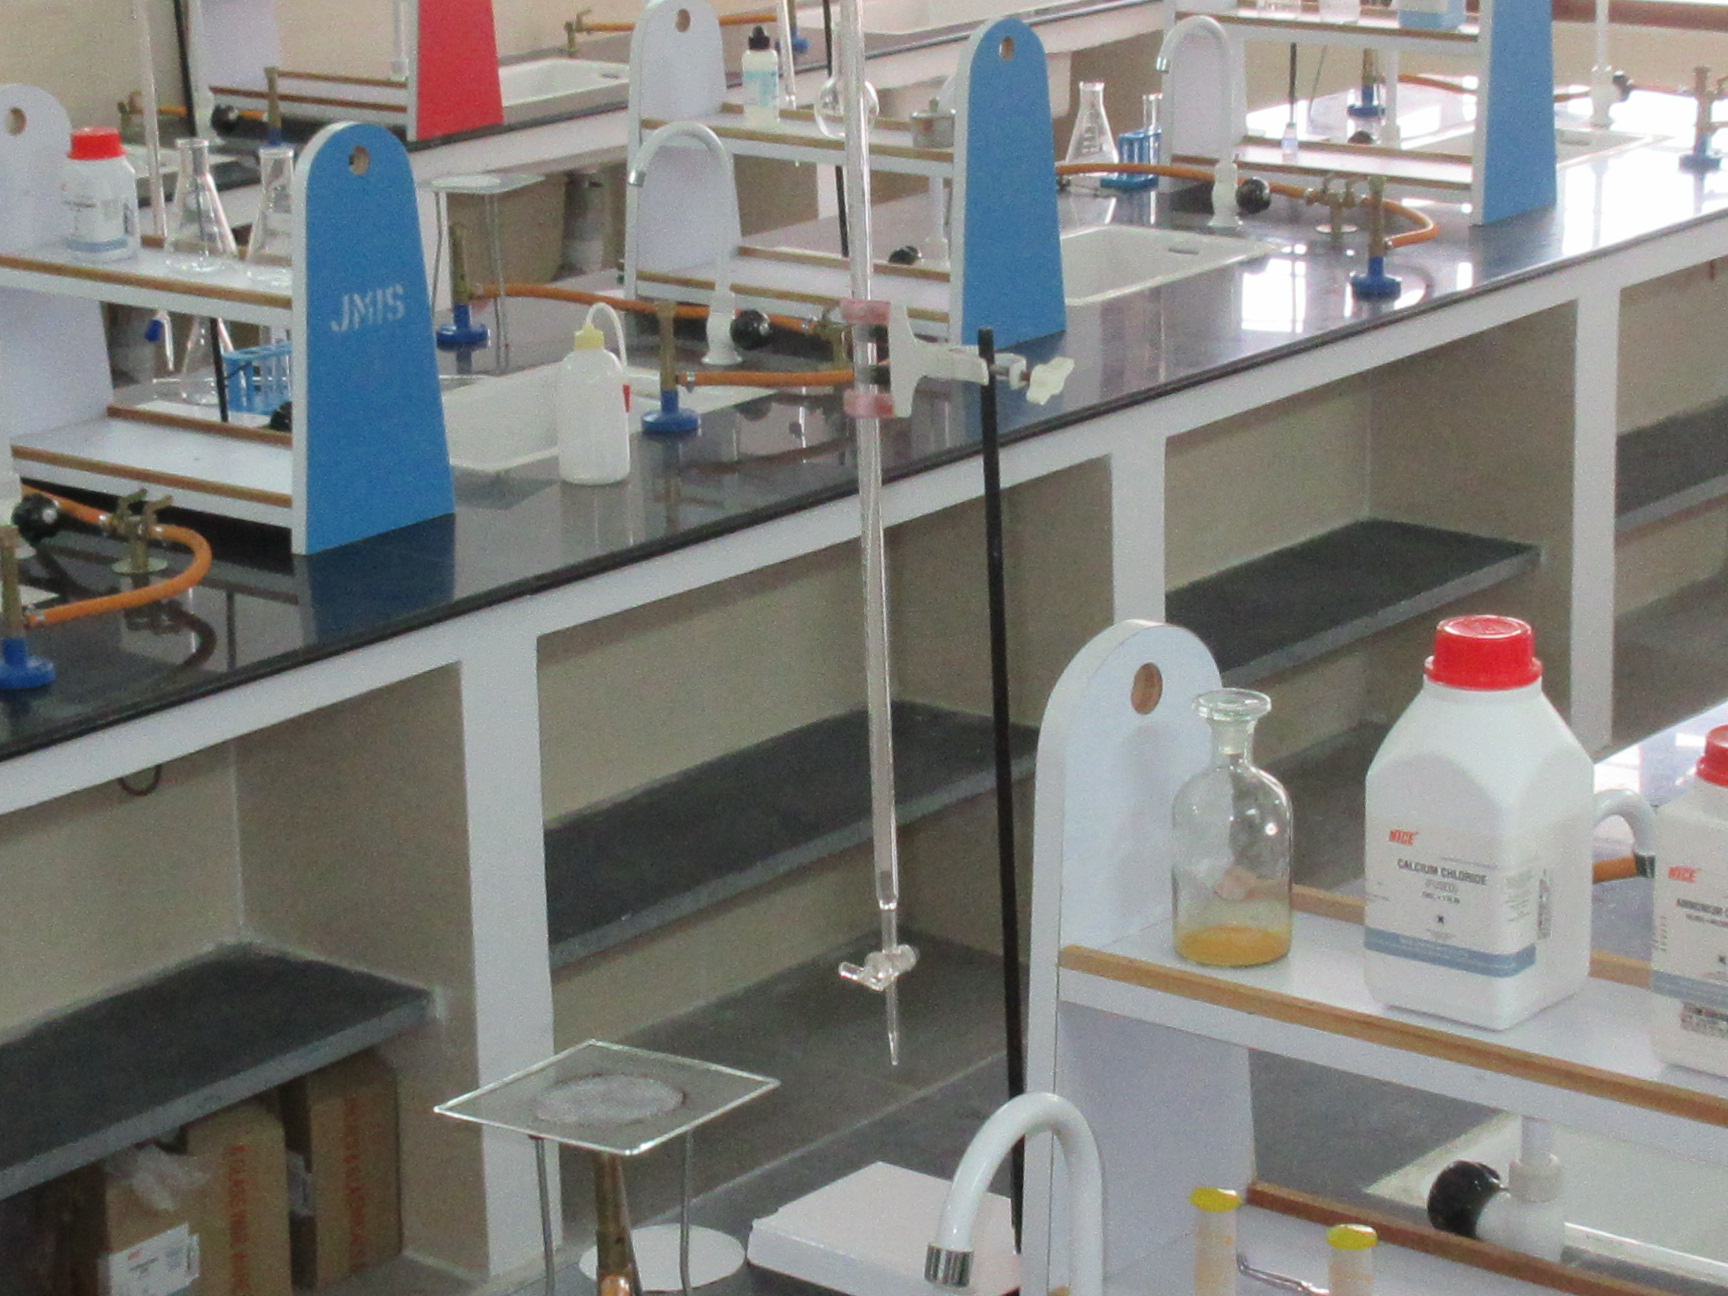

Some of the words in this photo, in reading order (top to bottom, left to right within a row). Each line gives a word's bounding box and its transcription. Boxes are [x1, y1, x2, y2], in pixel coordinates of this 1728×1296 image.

[330, 284, 406, 332] JMIS
[1397, 858, 1438, 876] CALCIUM
[1440, 867, 1487, 886] CHLORIDE
